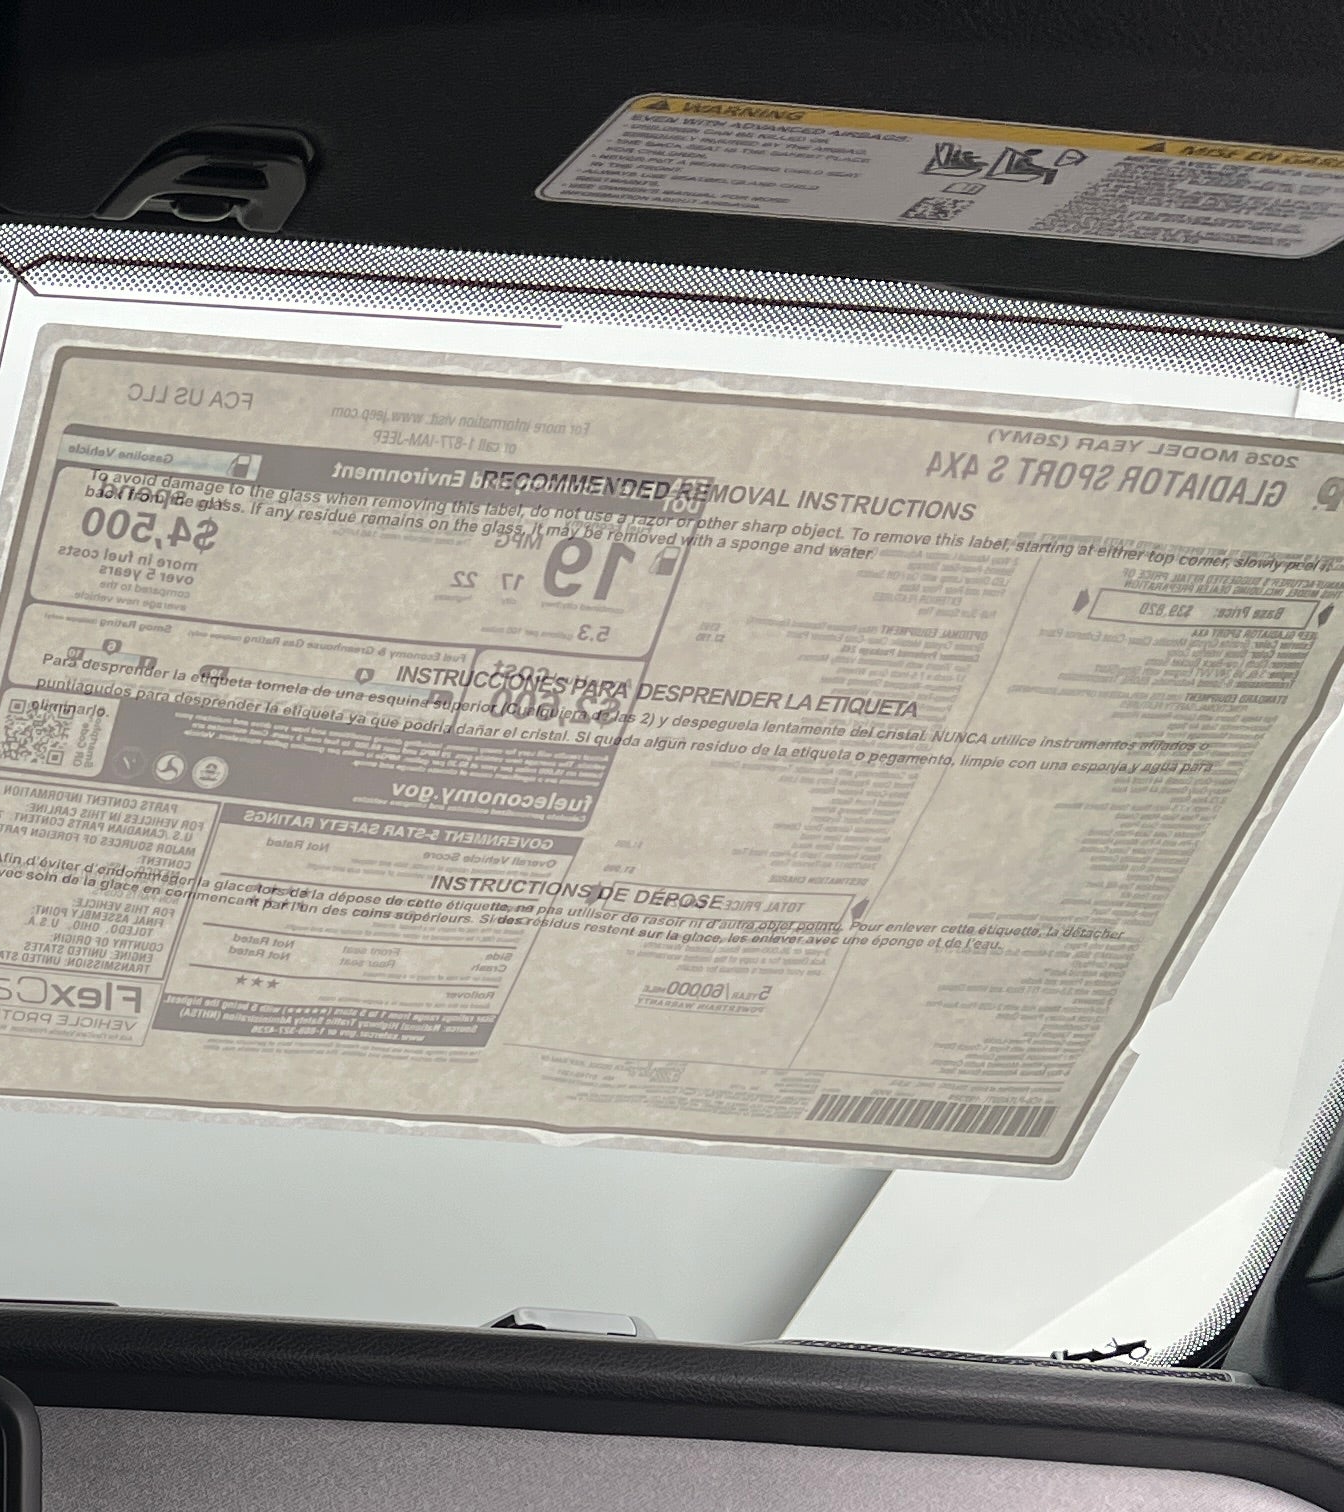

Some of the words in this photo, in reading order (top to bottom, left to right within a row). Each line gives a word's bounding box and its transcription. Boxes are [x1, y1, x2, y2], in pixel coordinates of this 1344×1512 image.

[683, 102, 805, 121] WARNING
[480, 470, 670, 501] RECOMMENDED
[674, 481, 790, 509] REMOVAL
[797, 490, 977, 521] INSTRUCTIONS
[396, 666, 567, 695] INSTRUCCIONES
[571, 679, 627, 700] PARA
[637, 683, 782, 710] DESPRENDER
[784, 692, 814, 711] LA
[815, 695, 919, 718] ETIQUETA
[430, 874, 592, 900] INSTRUCTIONS
[596, 886, 630, 903] DE
[633, 888, 726, 912] DÉPOSE
